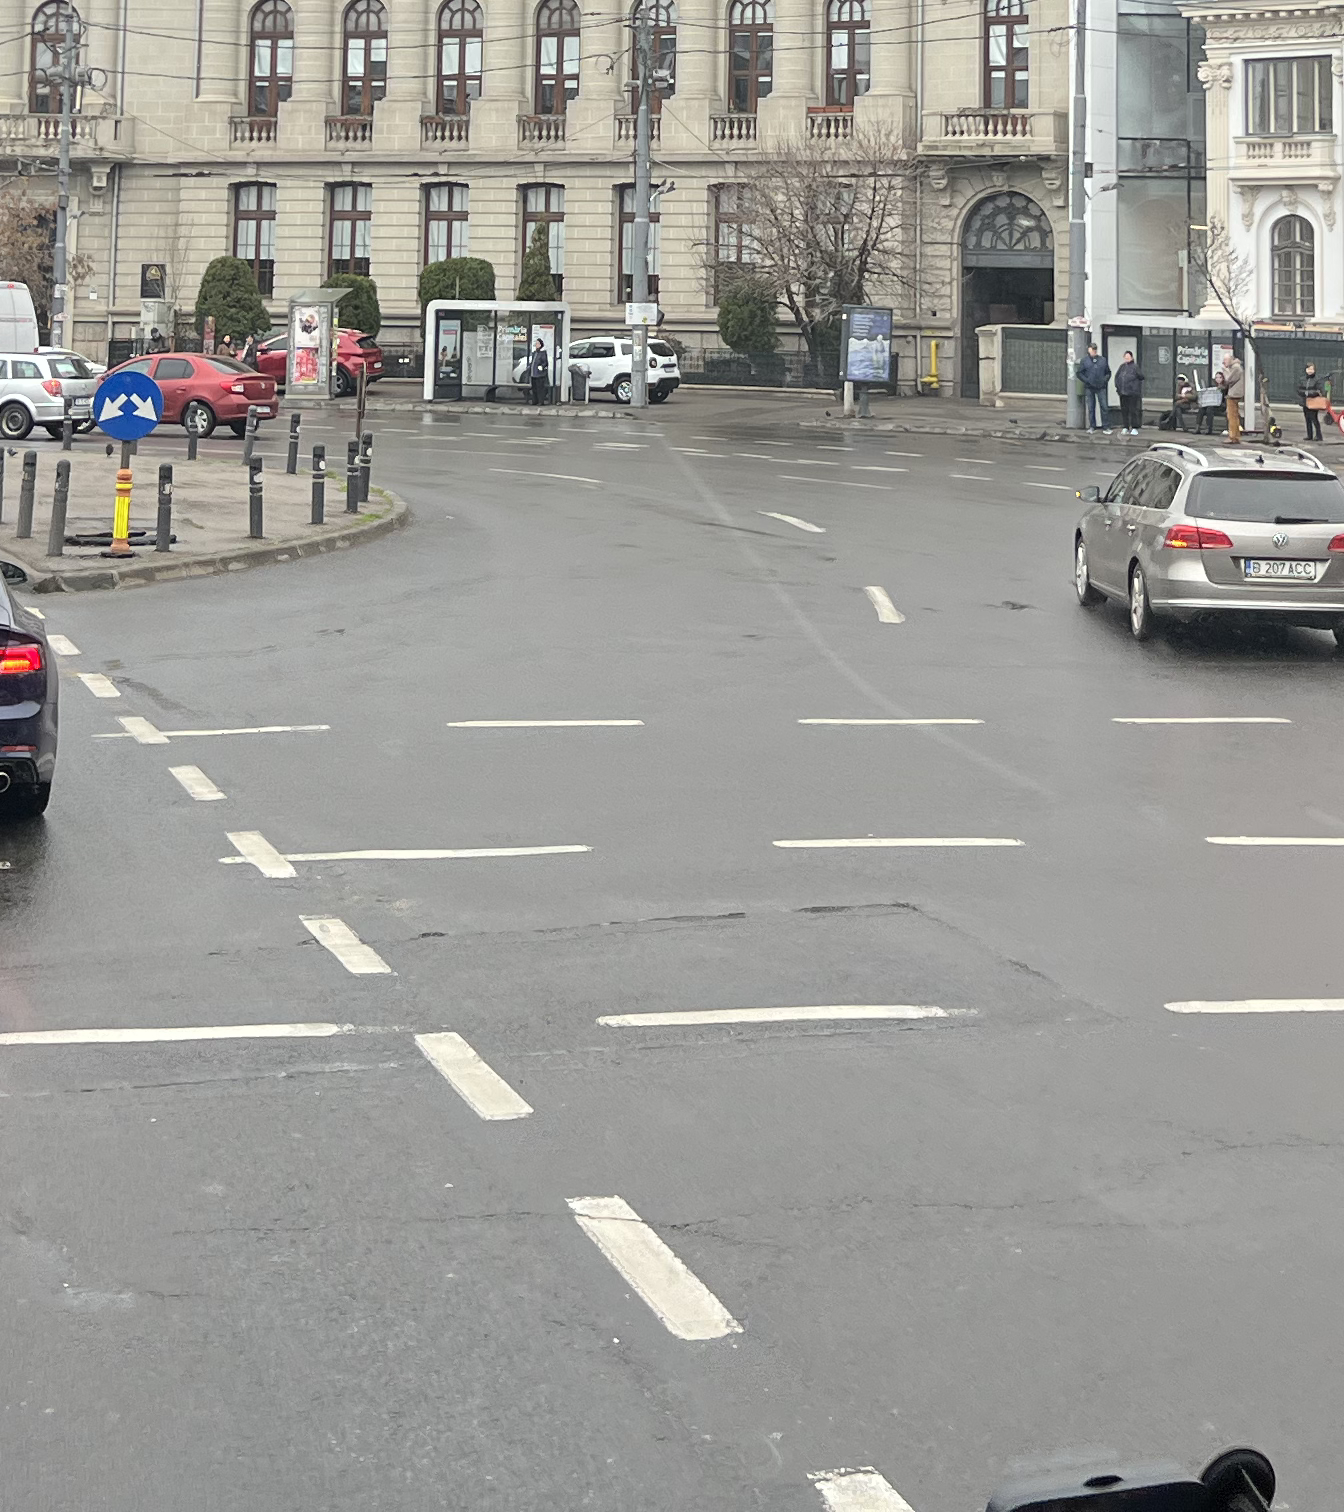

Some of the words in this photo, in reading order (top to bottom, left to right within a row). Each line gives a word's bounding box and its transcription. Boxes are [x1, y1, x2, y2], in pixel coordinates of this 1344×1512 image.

[1252, 562, 1261, 574] B
[1265, 562, 1286, 575] 207
[1288, 562, 1312, 575] ACC
